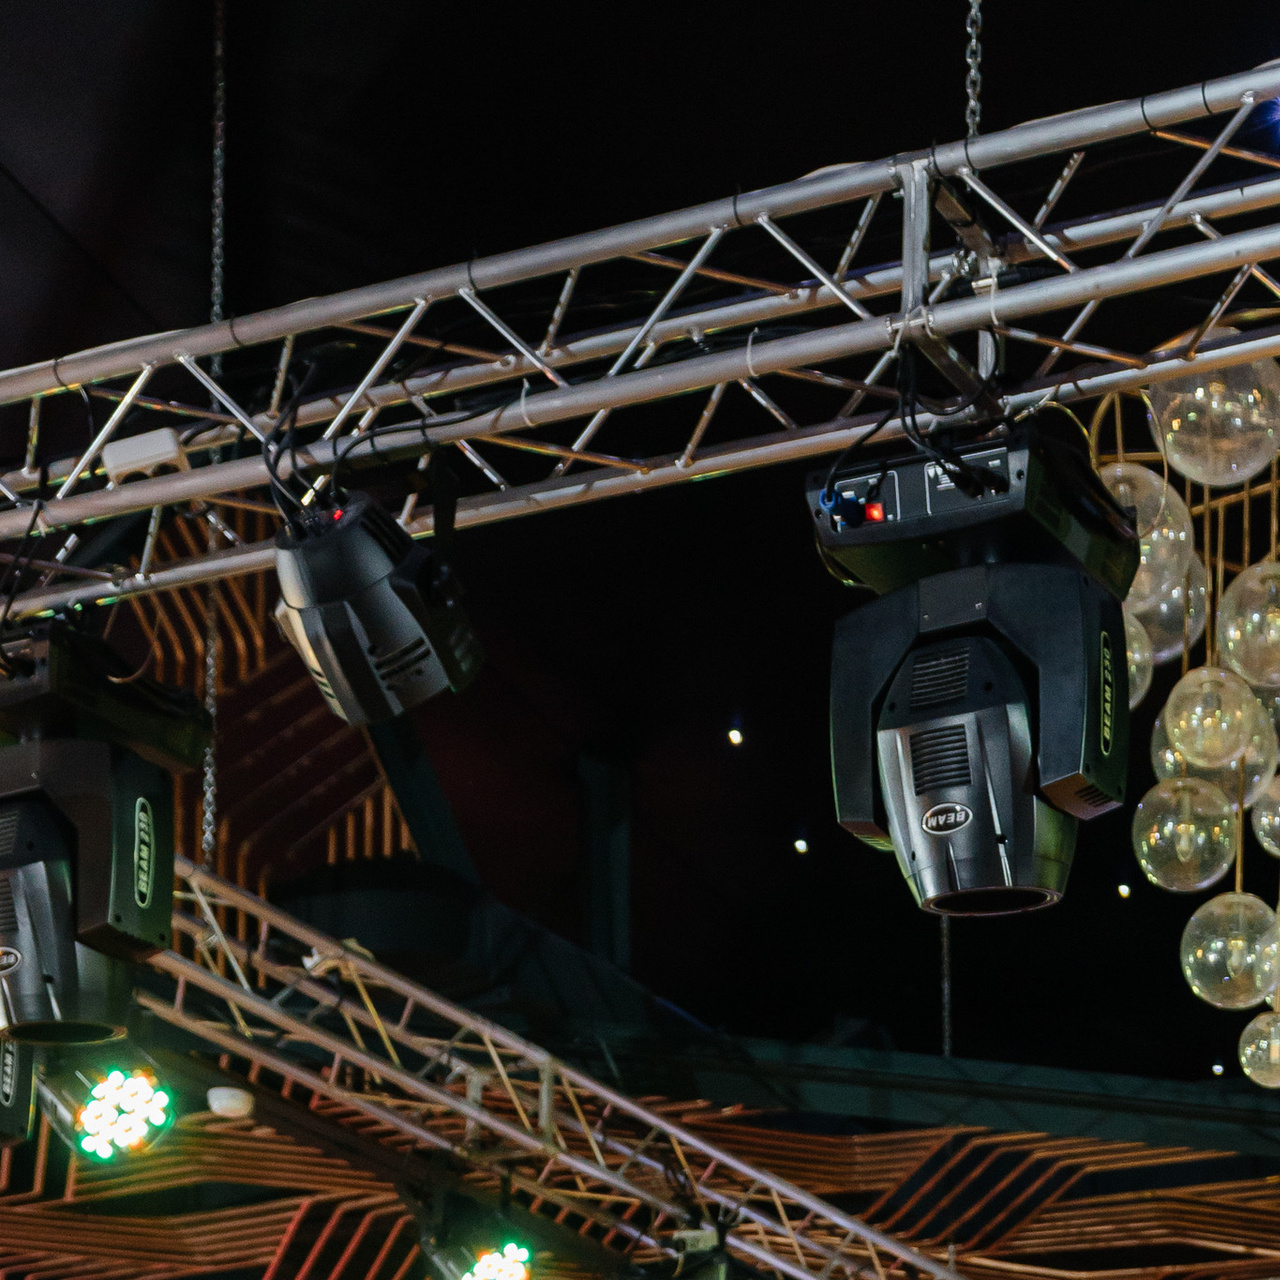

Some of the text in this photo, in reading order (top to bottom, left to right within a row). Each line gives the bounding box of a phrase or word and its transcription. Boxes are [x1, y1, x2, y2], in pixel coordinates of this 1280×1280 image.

[1103, 684, 1112, 740] BEAM
[927, 810, 966, 828] BEAM
[138, 844, 150, 894] BEAM
